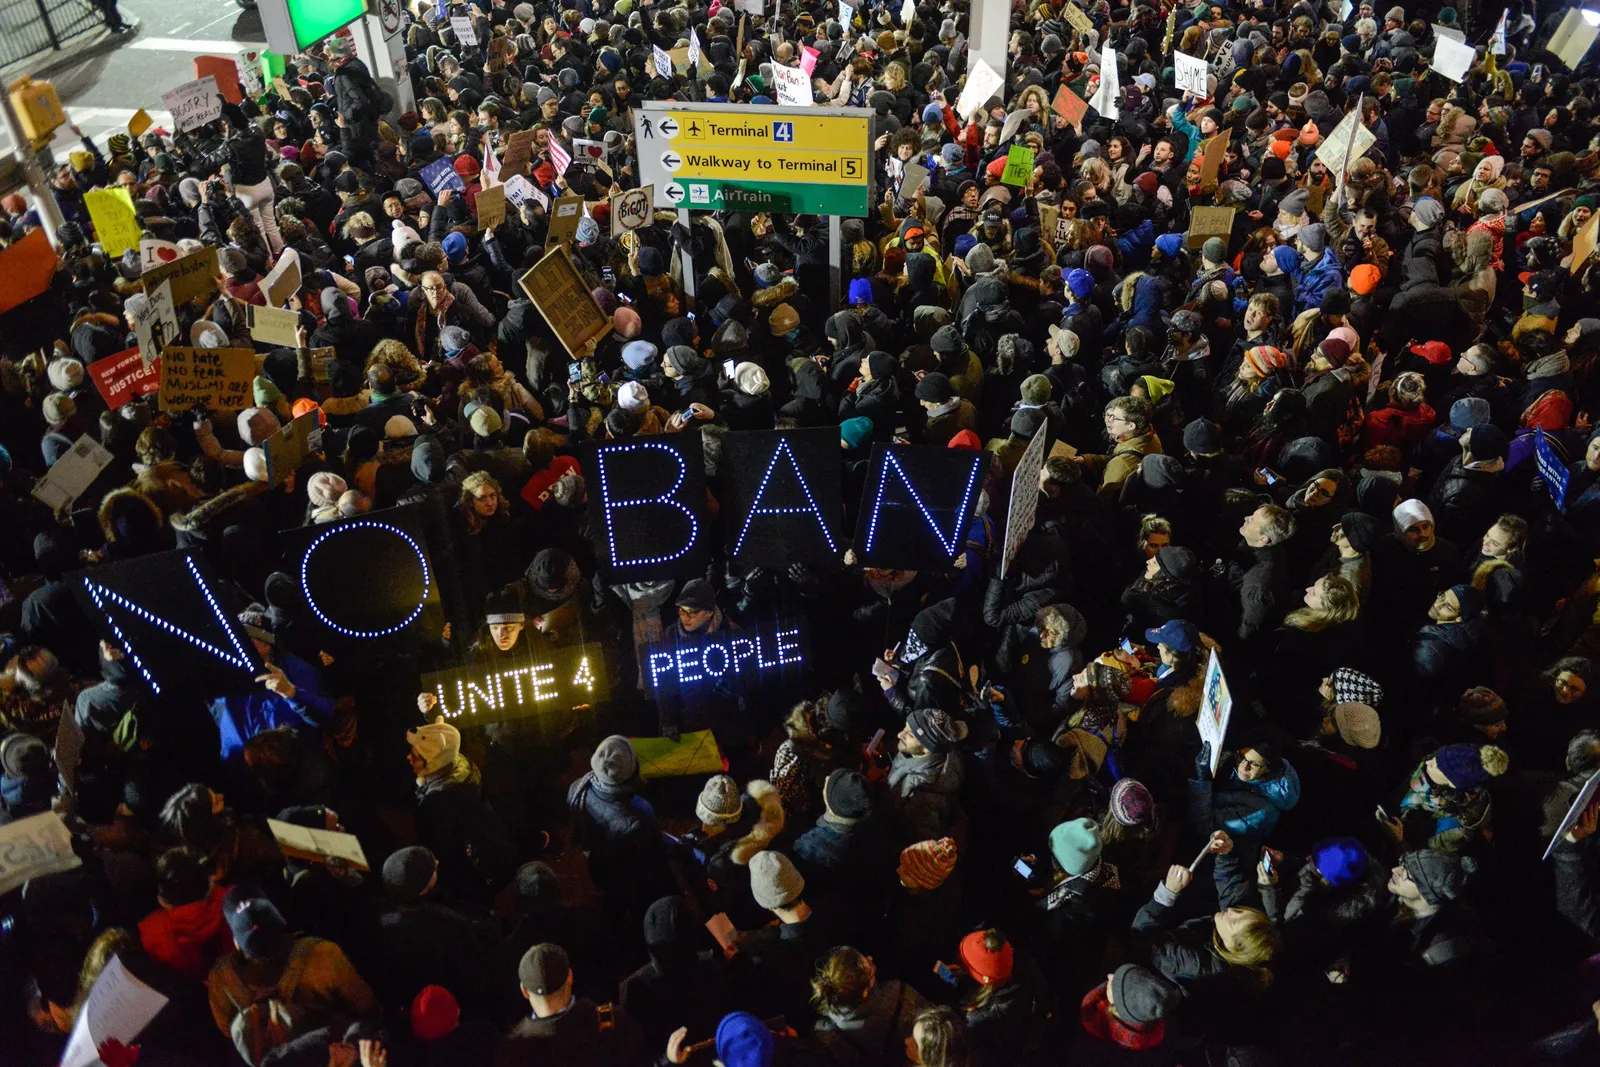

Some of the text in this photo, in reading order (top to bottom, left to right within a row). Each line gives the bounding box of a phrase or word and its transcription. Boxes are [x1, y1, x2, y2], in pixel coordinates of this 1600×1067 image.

[1176, 57, 1206, 92] SHAME
[170, 92, 209, 120] BIGOTRY
[180, 105, 221, 129] NOT REALIT
[709, 122, 791, 141] Terminal 4
[578, 144, 585, 157] I
[686, 154, 856, 175] Walkway to Terminal 5
[713, 188, 772, 203] AirTrain
[146, 246, 154, 263] I
[166, 351, 185, 362] NO
[101, 366, 116, 378] NEW
[109, 364, 156, 396] JUSTICE!
[168, 365, 188, 376] NO
[597, 437, 981, 567] BAN
[649, 628, 803, 687] PEOPLE
[436, 656, 595, 719] UNITE 4
